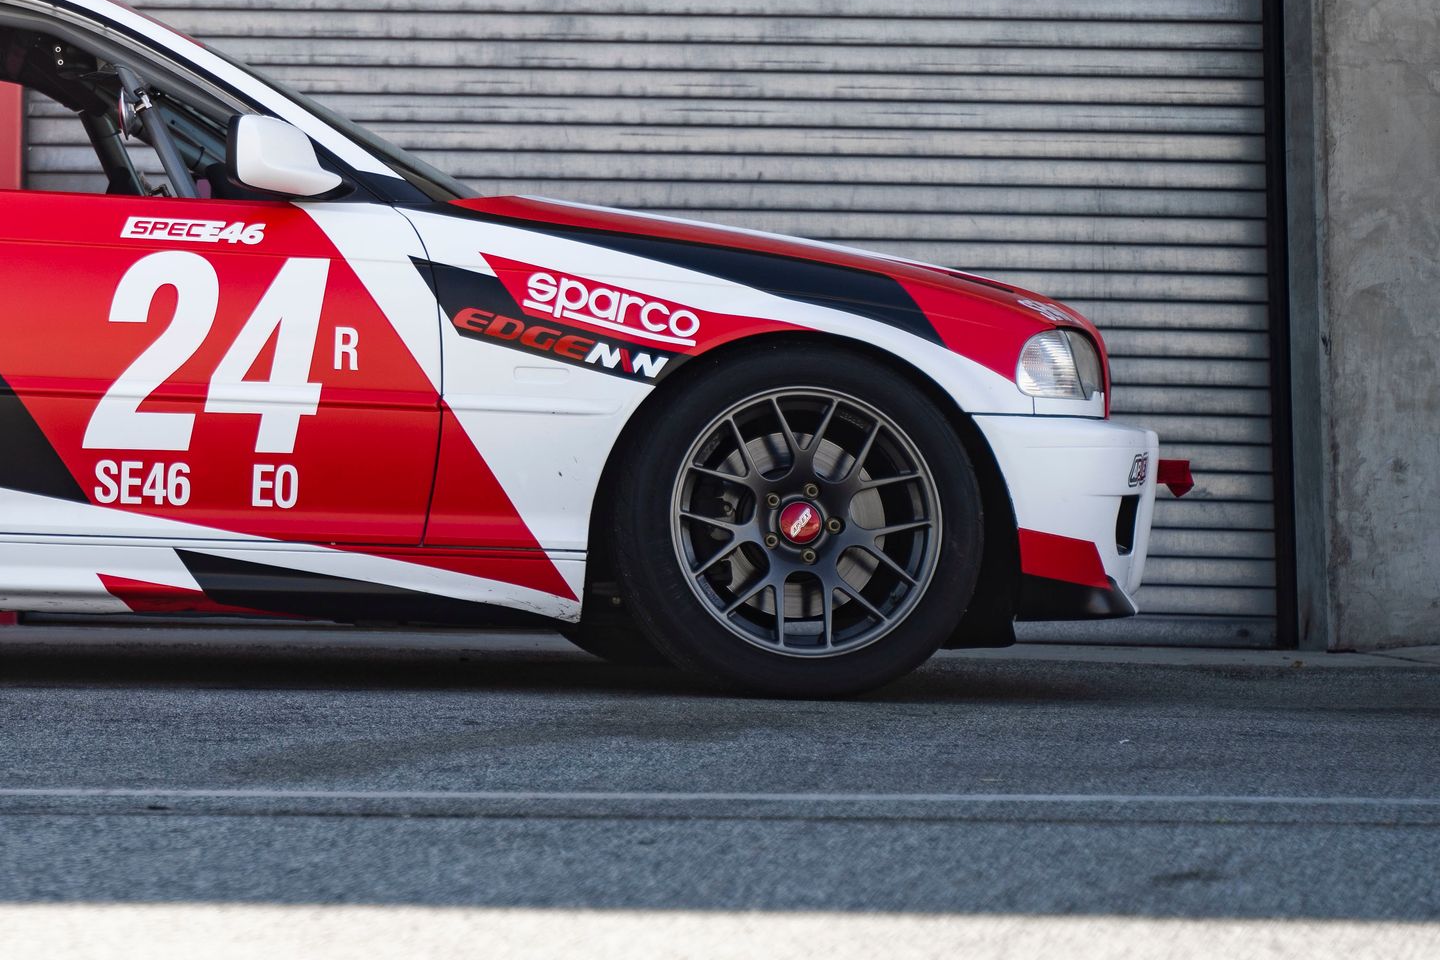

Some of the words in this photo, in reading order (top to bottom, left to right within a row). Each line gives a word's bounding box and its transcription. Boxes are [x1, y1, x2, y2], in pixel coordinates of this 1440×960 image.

[526, 271, 701, 339] sparco
[81, 250, 331, 454] 24
[333, 326, 359, 371] R
[94, 458, 191, 506] SE46
